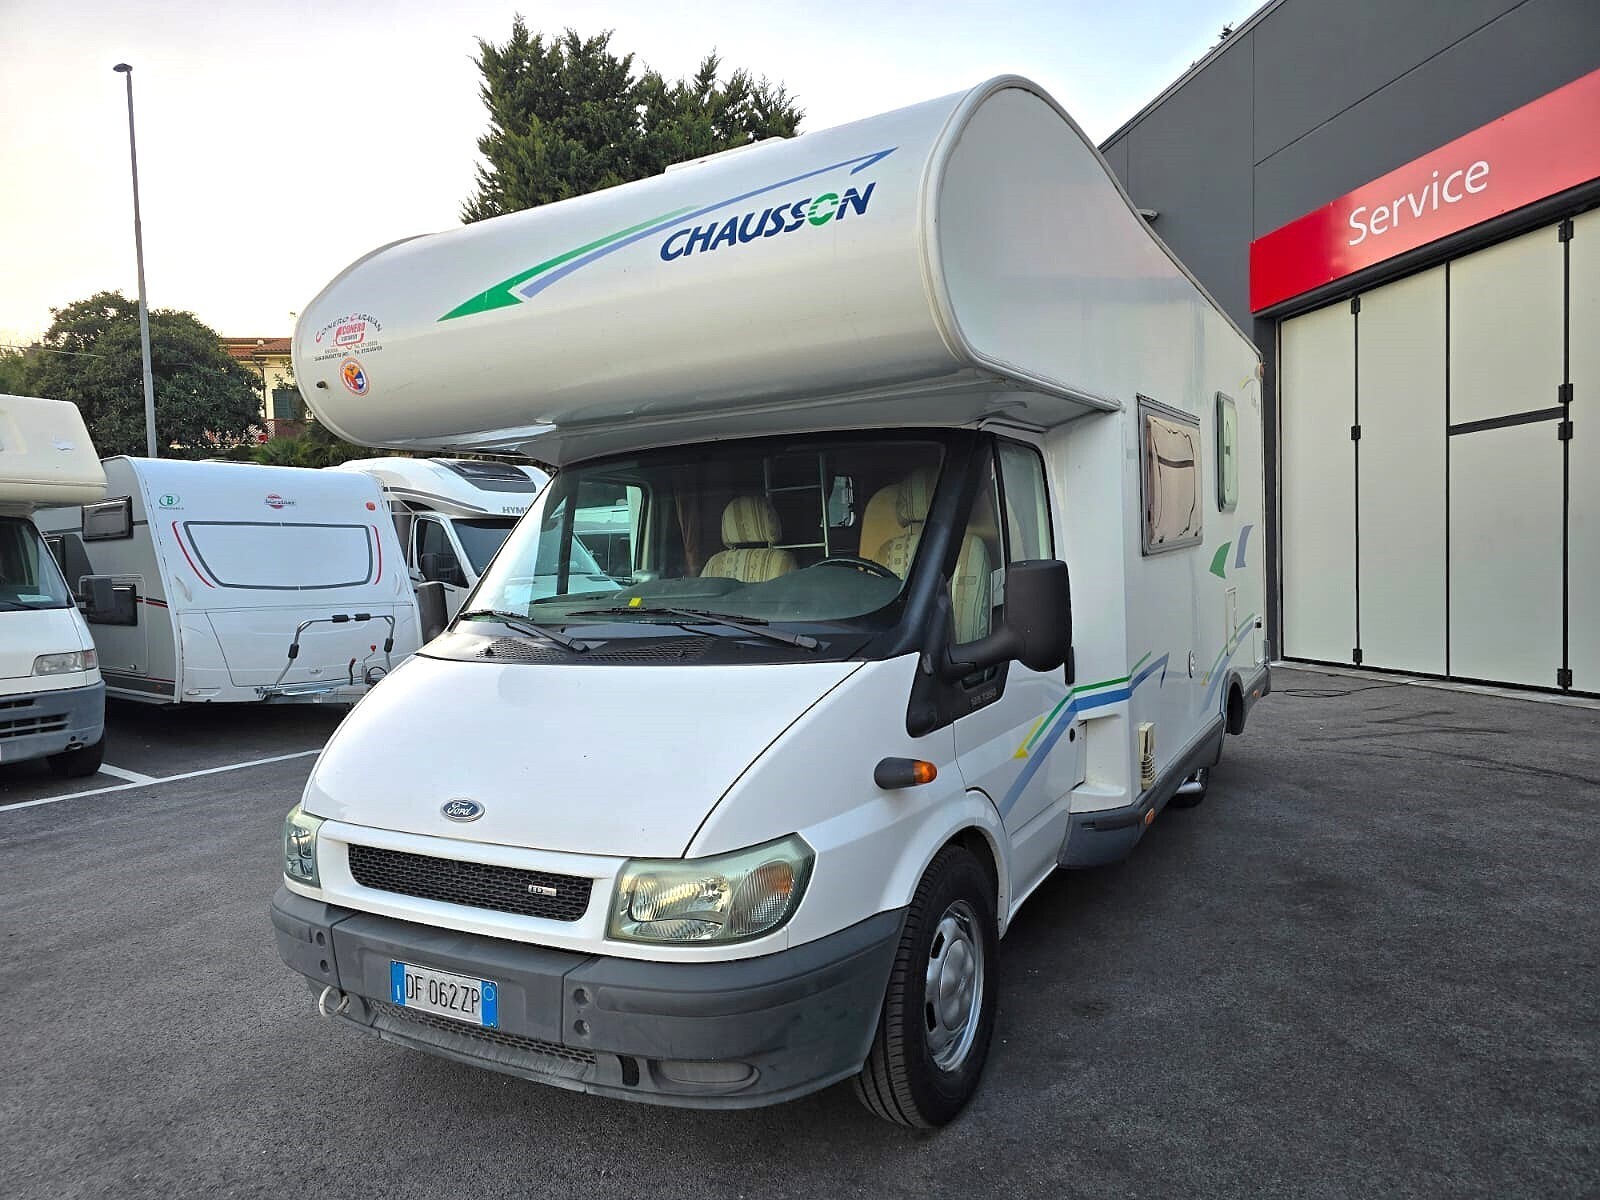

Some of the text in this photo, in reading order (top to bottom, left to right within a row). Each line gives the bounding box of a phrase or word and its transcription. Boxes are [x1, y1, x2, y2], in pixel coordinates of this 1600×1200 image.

[660, 181, 877, 262] CHAUSSON
[1348, 160, 1490, 246] Service
[405, 973, 423, 1001] DF
[429, 979, 481, 1014] 062ZP
